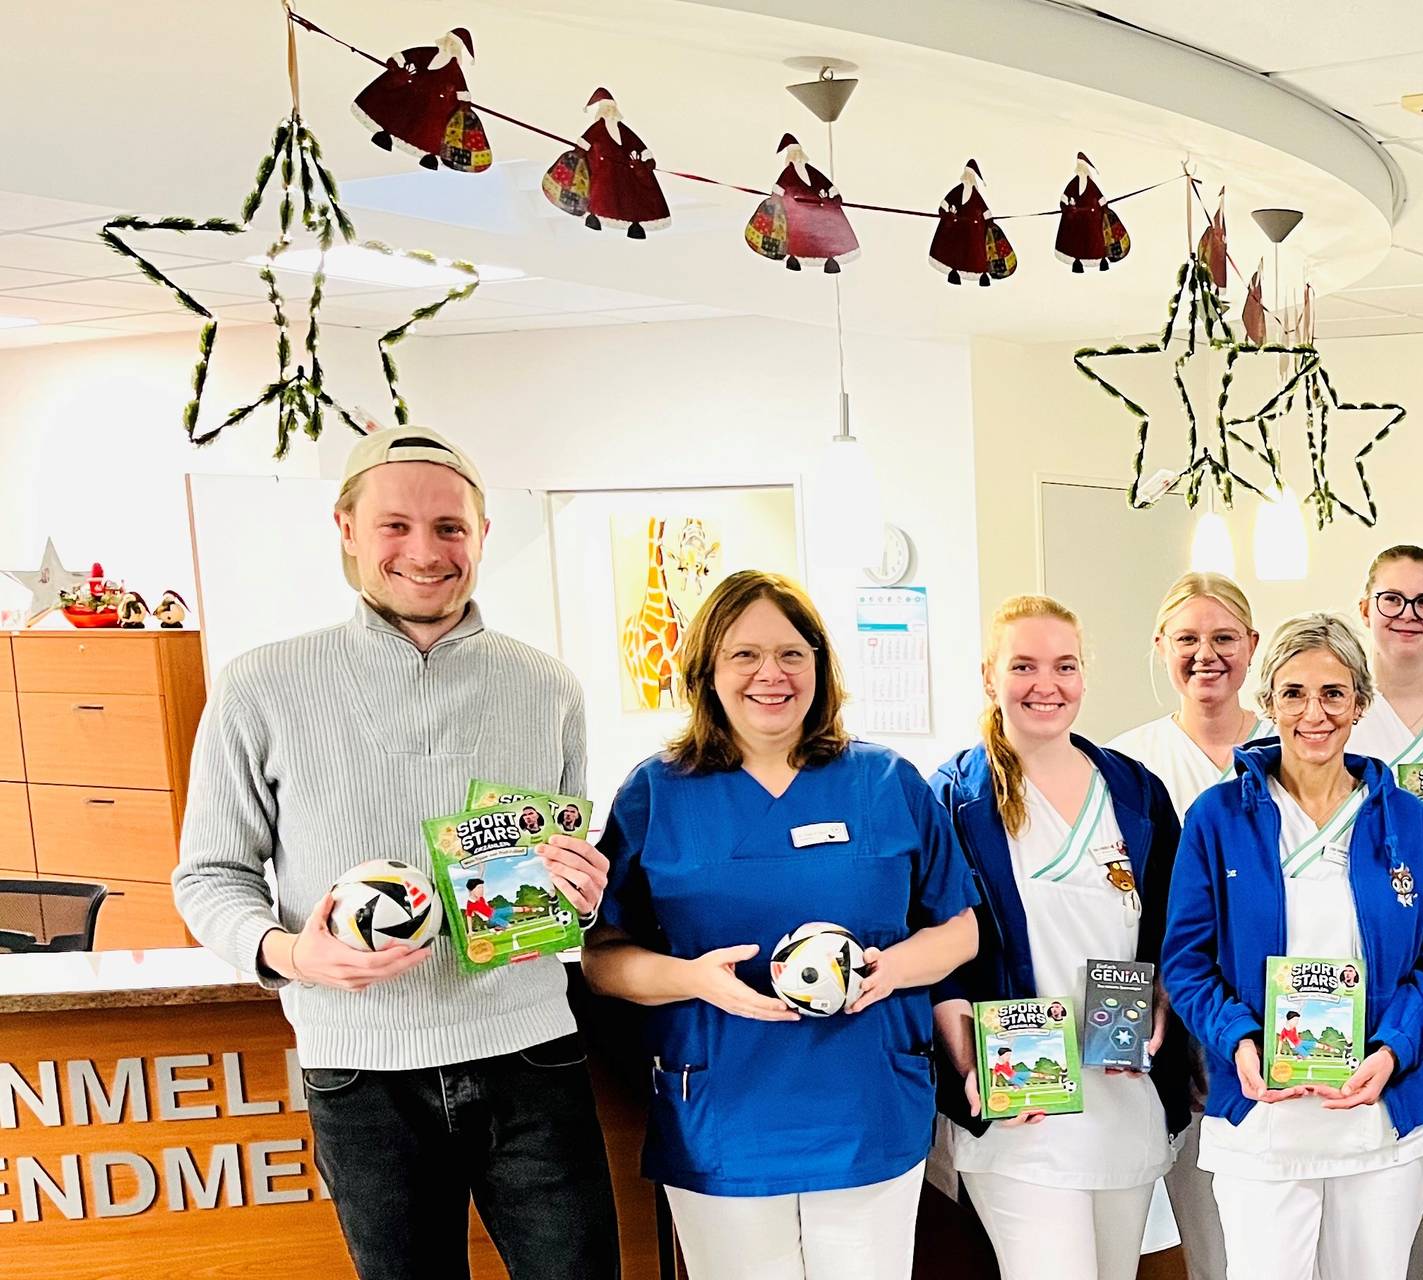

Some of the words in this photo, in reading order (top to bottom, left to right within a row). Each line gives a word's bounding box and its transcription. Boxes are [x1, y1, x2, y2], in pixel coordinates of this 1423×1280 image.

[457, 812, 517, 838] SPORT
[461, 826, 521, 850] STARS
[1292, 962, 1340, 977] SPORT
[1292, 974, 1339, 989] STARS
[998, 1003, 1046, 1017] SPORT
[1000, 1013, 1047, 1027] STARS
[0, 1138, 332, 1224] NDME
